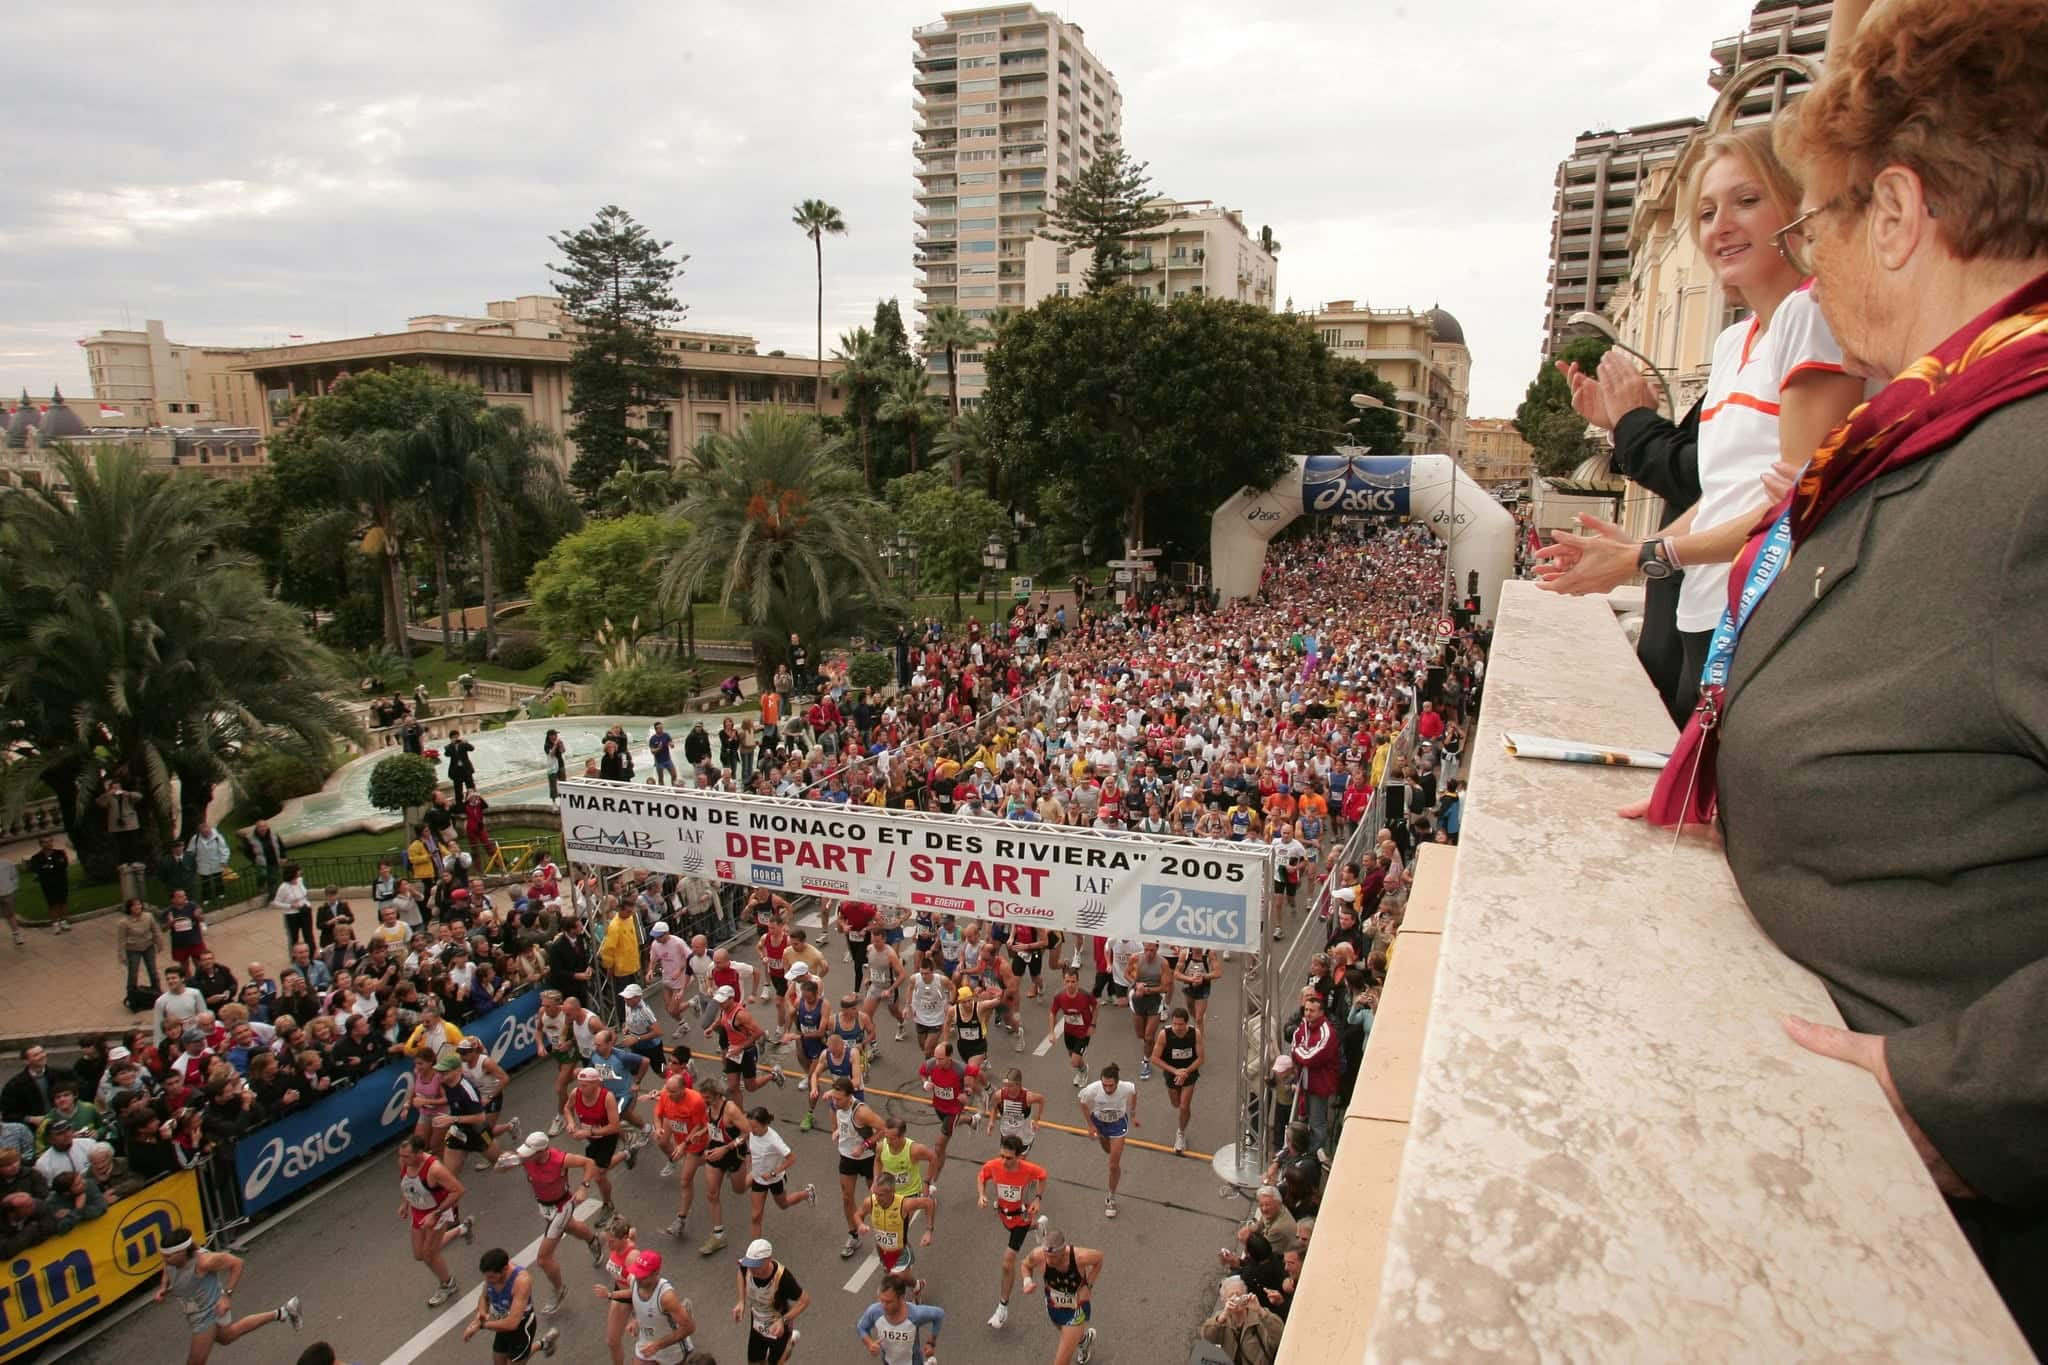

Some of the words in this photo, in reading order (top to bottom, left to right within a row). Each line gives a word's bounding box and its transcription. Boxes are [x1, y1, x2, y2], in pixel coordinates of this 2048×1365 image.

[1342, 487, 1395, 512] asics
[559, 792, 698, 822] "MARATHON
[708, 808, 739, 827] DE
[750, 813, 866, 841] MONACO
[879, 827, 913, 846] ET
[926, 831, 983, 854] DES
[996, 838, 1147, 871] RIVIERA"
[1160, 856, 1245, 883] 2005
[570, 824, 656, 850] CMB
[678, 826, 704, 844] IAF
[725, 831, 873, 875] DEPART
[886, 851, 896, 878] /
[909, 853, 1050, 898] START
[1074, 874, 1114, 895] IAF
[1005, 902, 1055, 918] Casino
[1176, 903, 1239, 941] asics
[282, 1117, 352, 1178] asics
[1003, 1189, 1016, 1200] 52
[876, 1234, 894, 1247] 203
[882, 1329, 909, 1343] 1625
